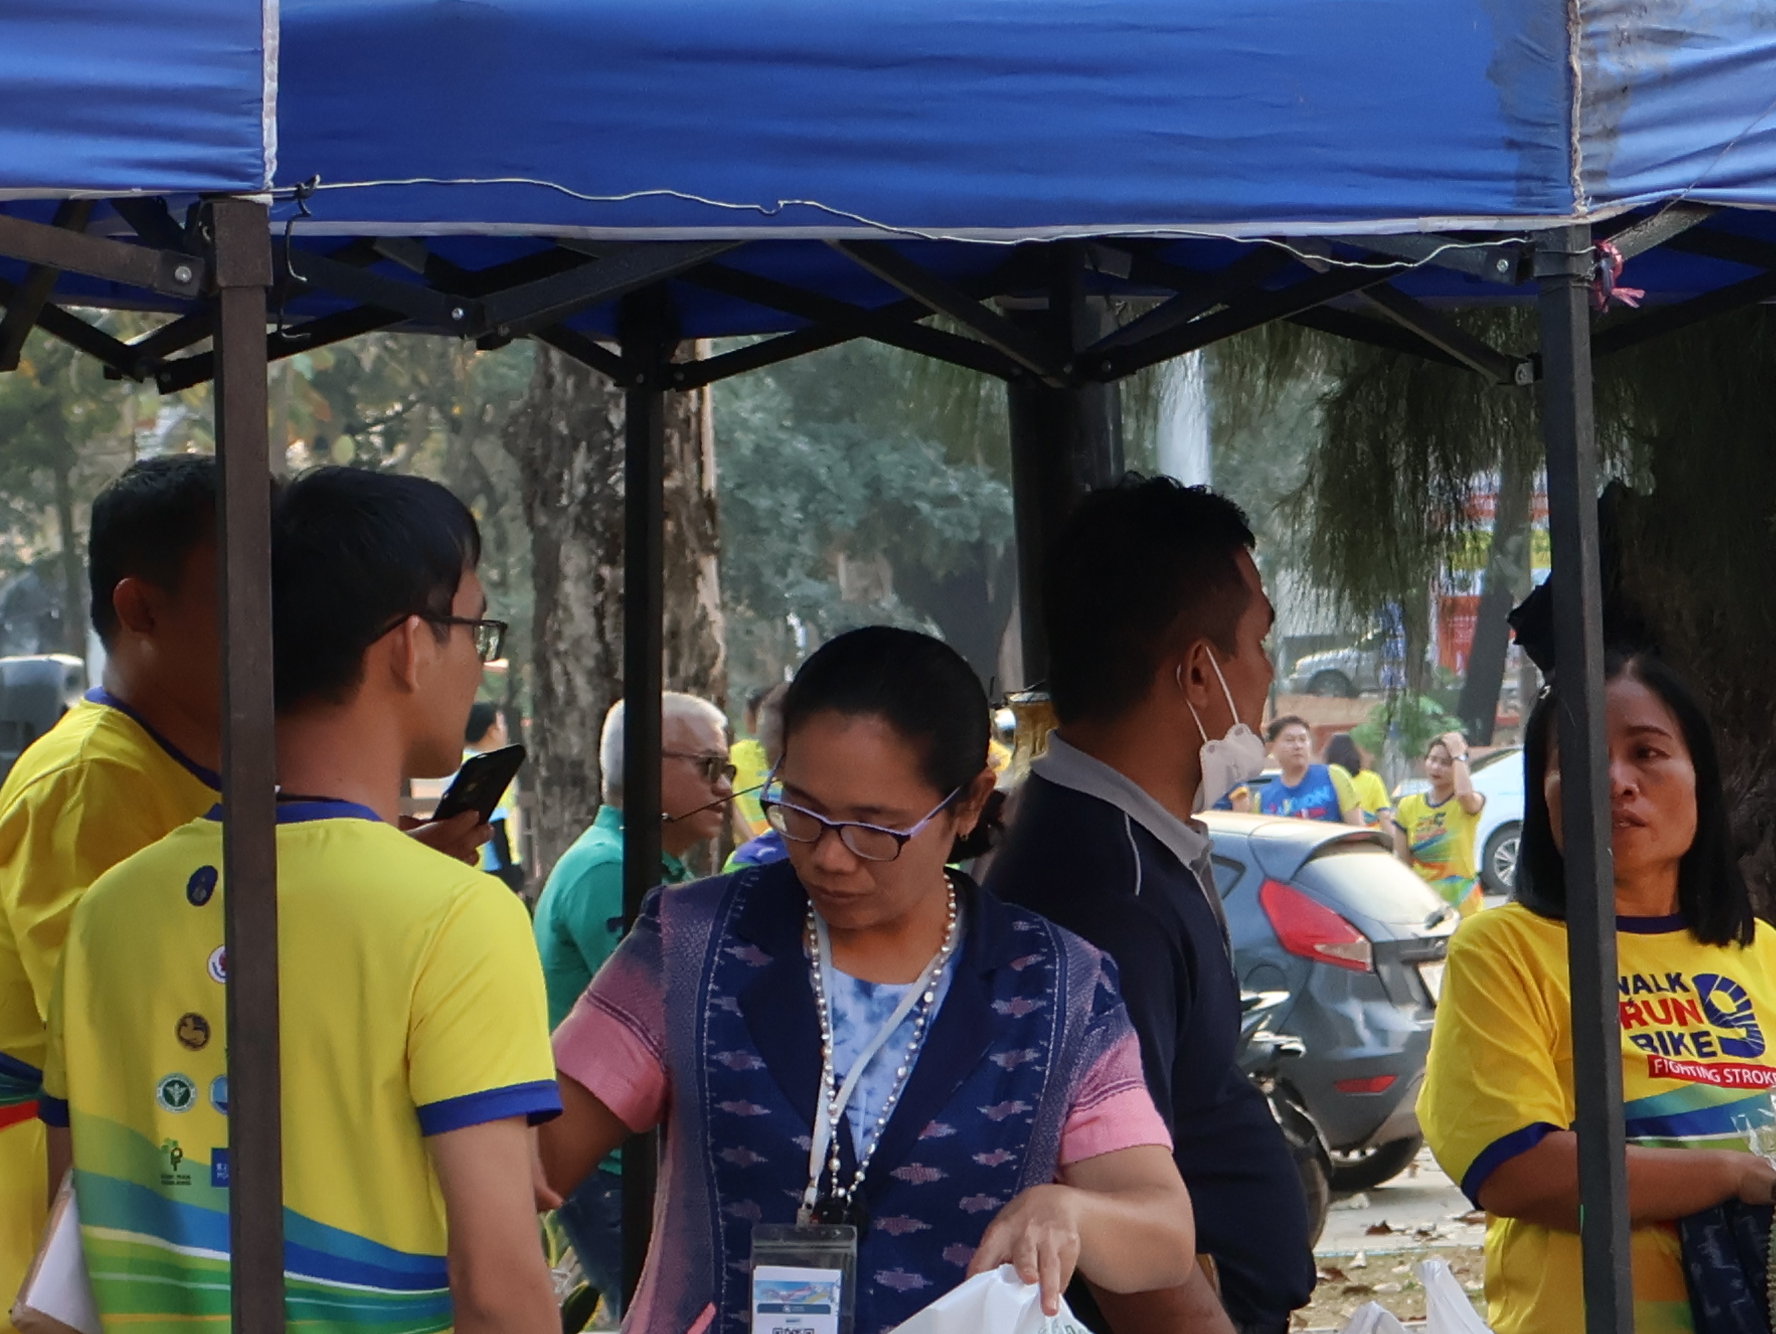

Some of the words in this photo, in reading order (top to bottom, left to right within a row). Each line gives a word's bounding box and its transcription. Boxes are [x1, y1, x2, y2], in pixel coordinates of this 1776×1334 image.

[1619, 997, 1704, 1030] RUN
[1629, 1030, 1718, 1059] BIKE
[1653, 1058, 1721, 1083] FIGHTING
